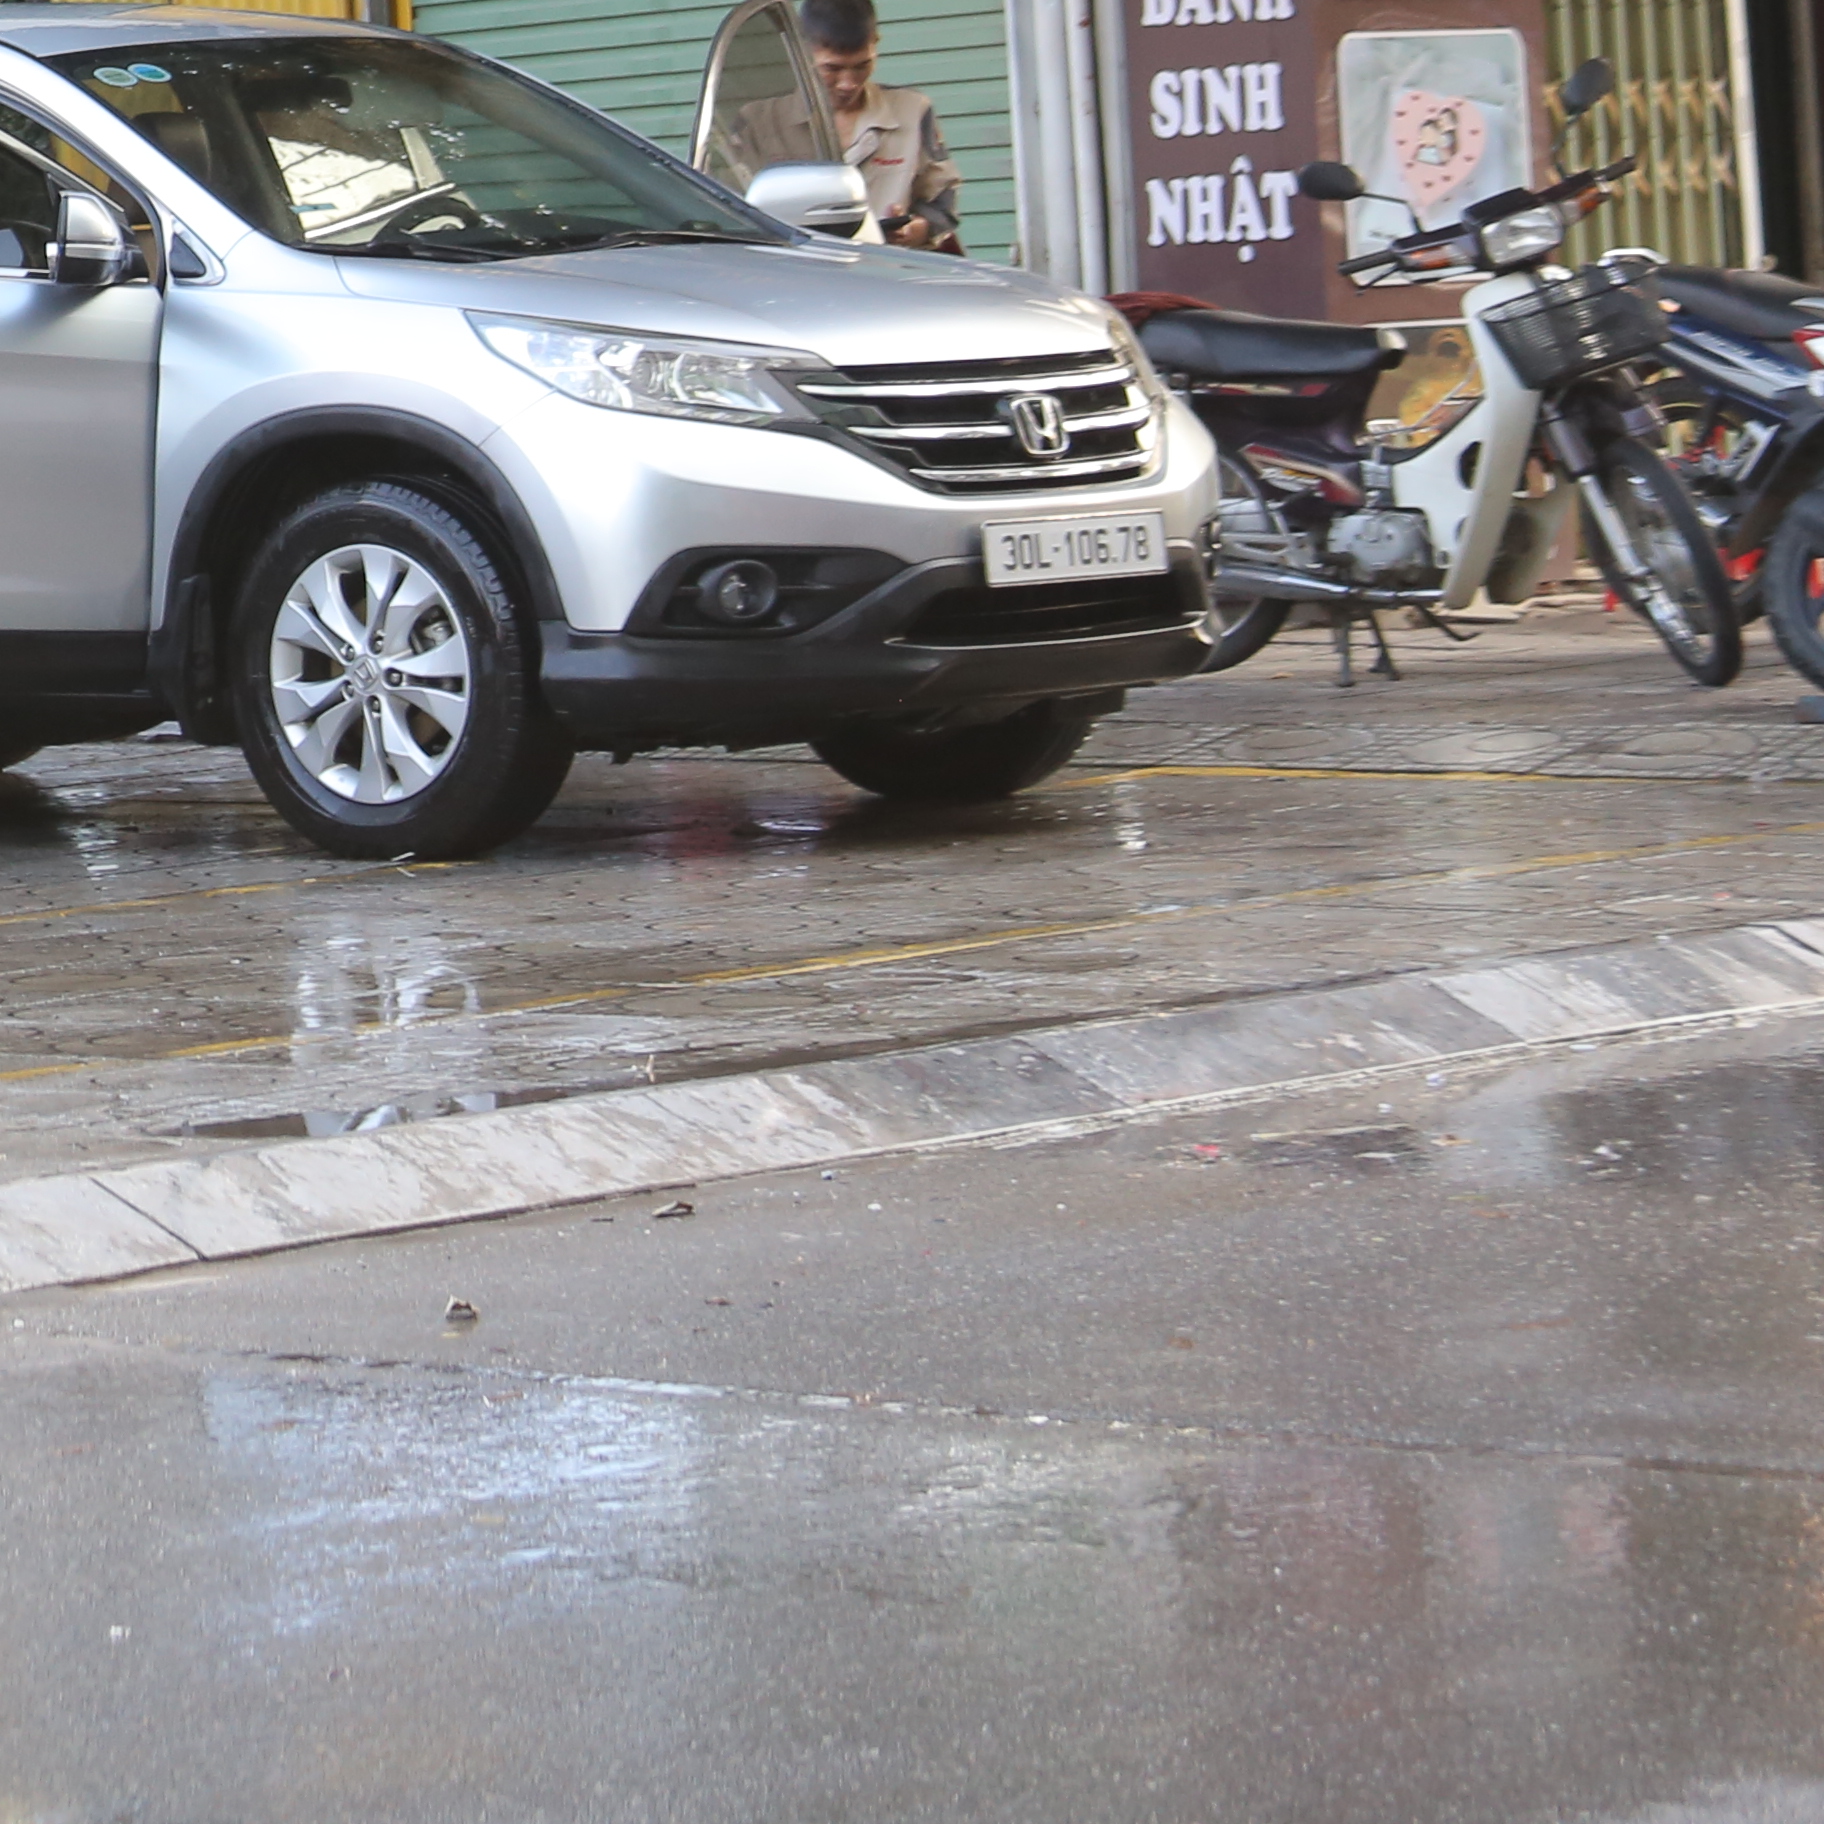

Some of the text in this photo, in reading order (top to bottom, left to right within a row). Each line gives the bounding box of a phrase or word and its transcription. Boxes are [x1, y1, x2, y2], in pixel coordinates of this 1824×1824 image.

[1150, 63, 1284, 138] SINH
[1145, 155, 1298, 263] NHẬT
[1001, 525, 1149, 572] 30L-106.78
